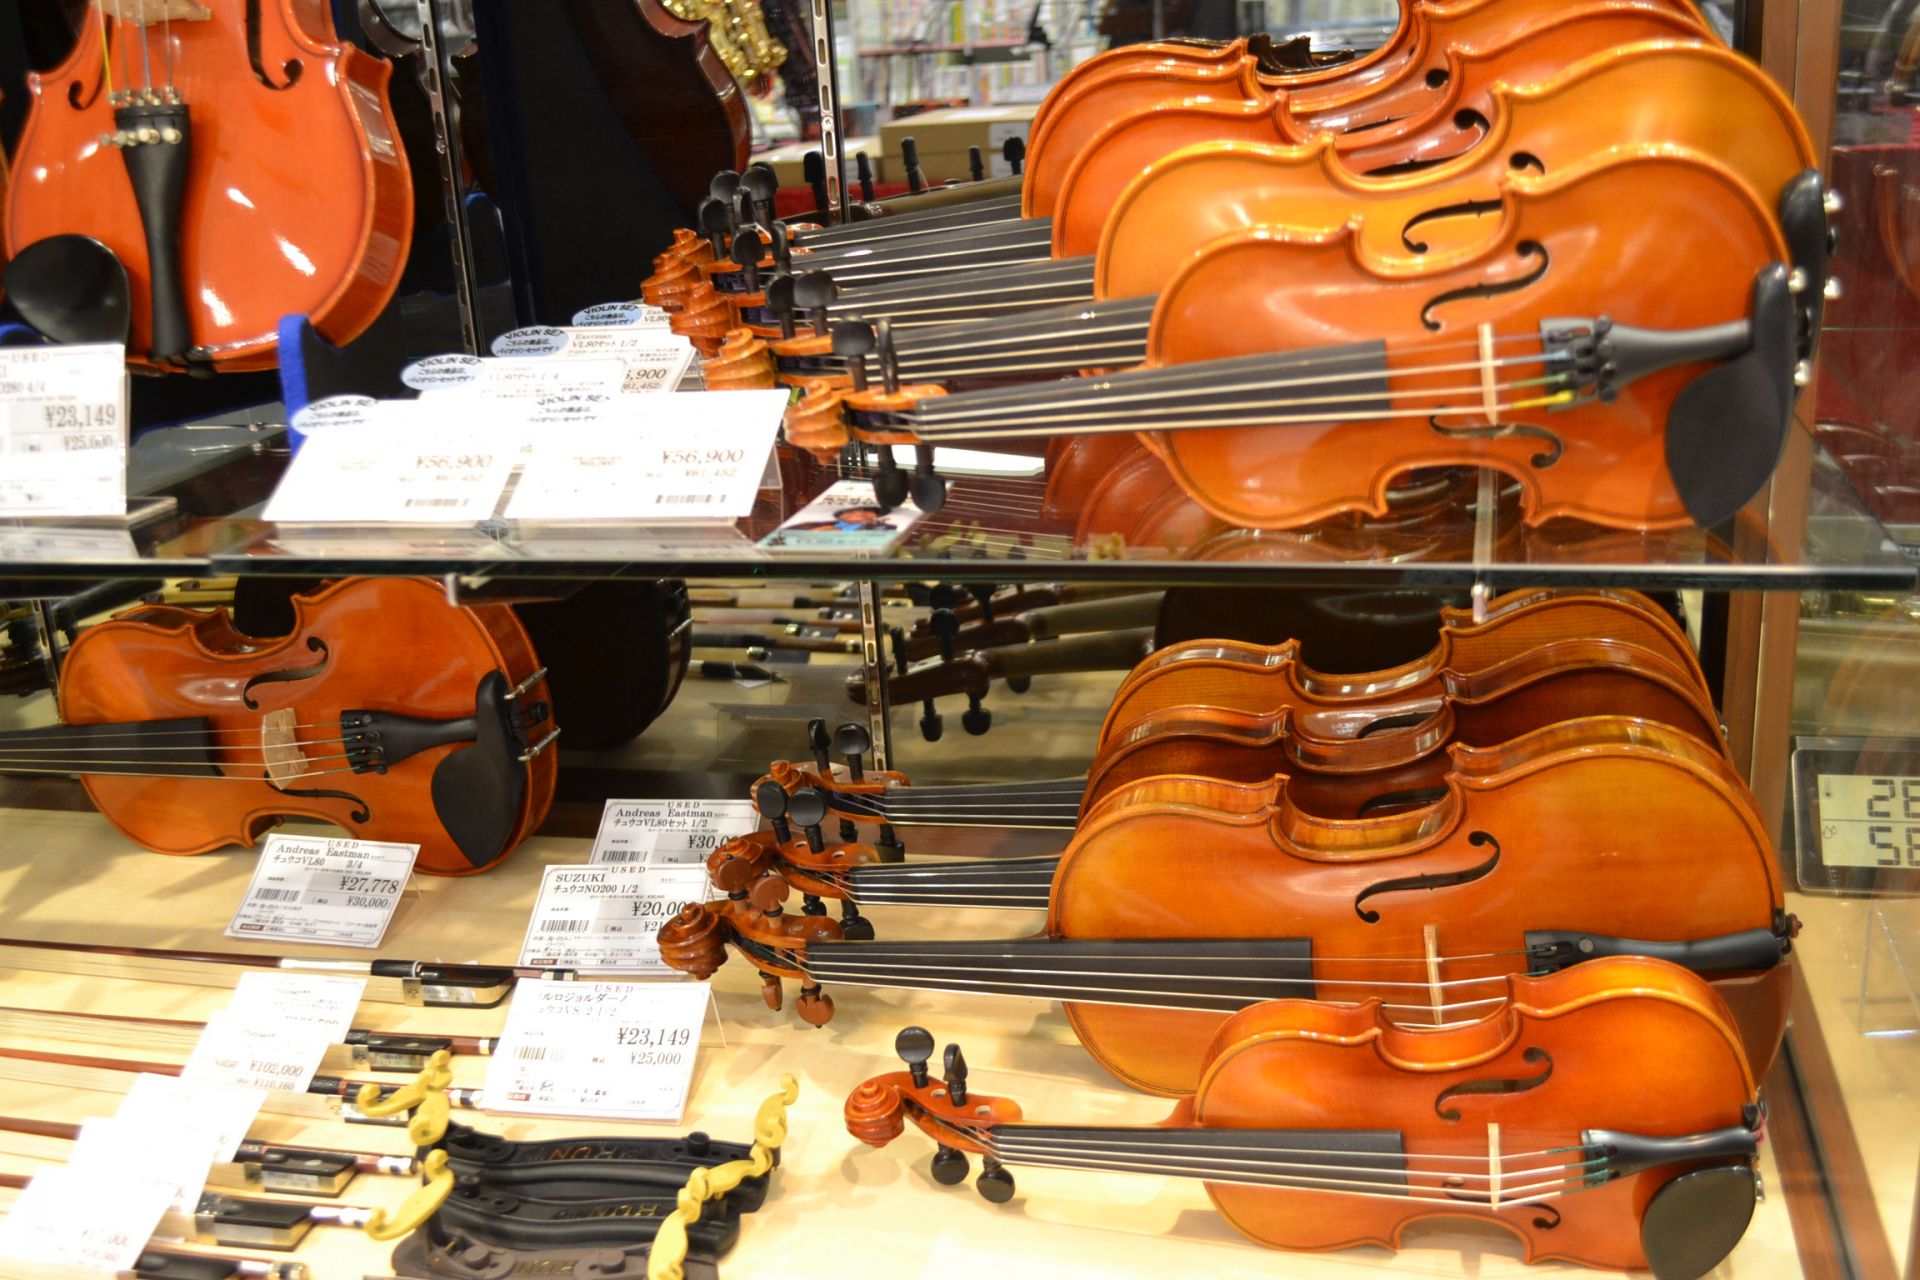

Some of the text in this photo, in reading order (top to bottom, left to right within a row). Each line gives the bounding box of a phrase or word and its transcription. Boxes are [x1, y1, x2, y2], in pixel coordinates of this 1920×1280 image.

[45, 404, 116, 429] ¥23,149
[416, 455, 494, 469] ¥56,900
[663, 449, 745, 465] ¥56,900
[615, 808, 714, 817] Andreas Eastman
[691, 819, 709, 828] 1/2
[327, 839, 360, 849] USED
[687, 834, 738, 850] ¥30,0
[276, 843, 370, 860] Andreas Eastman
[272, 855, 363, 870] チュウコVL80 3/4
[555, 873, 606, 883] SUZUKI
[339, 876, 400, 895] ¥27,778
[621, 884, 639, 894] 1/2
[346, 895, 389, 909] ¥30,000
[594, 984, 635, 993] USED
[617, 1027, 690, 1047] ¥23,149
[630, 1052, 682, 1066] ¥25,000
[249, 1059, 304, 1077] ¥102,000
